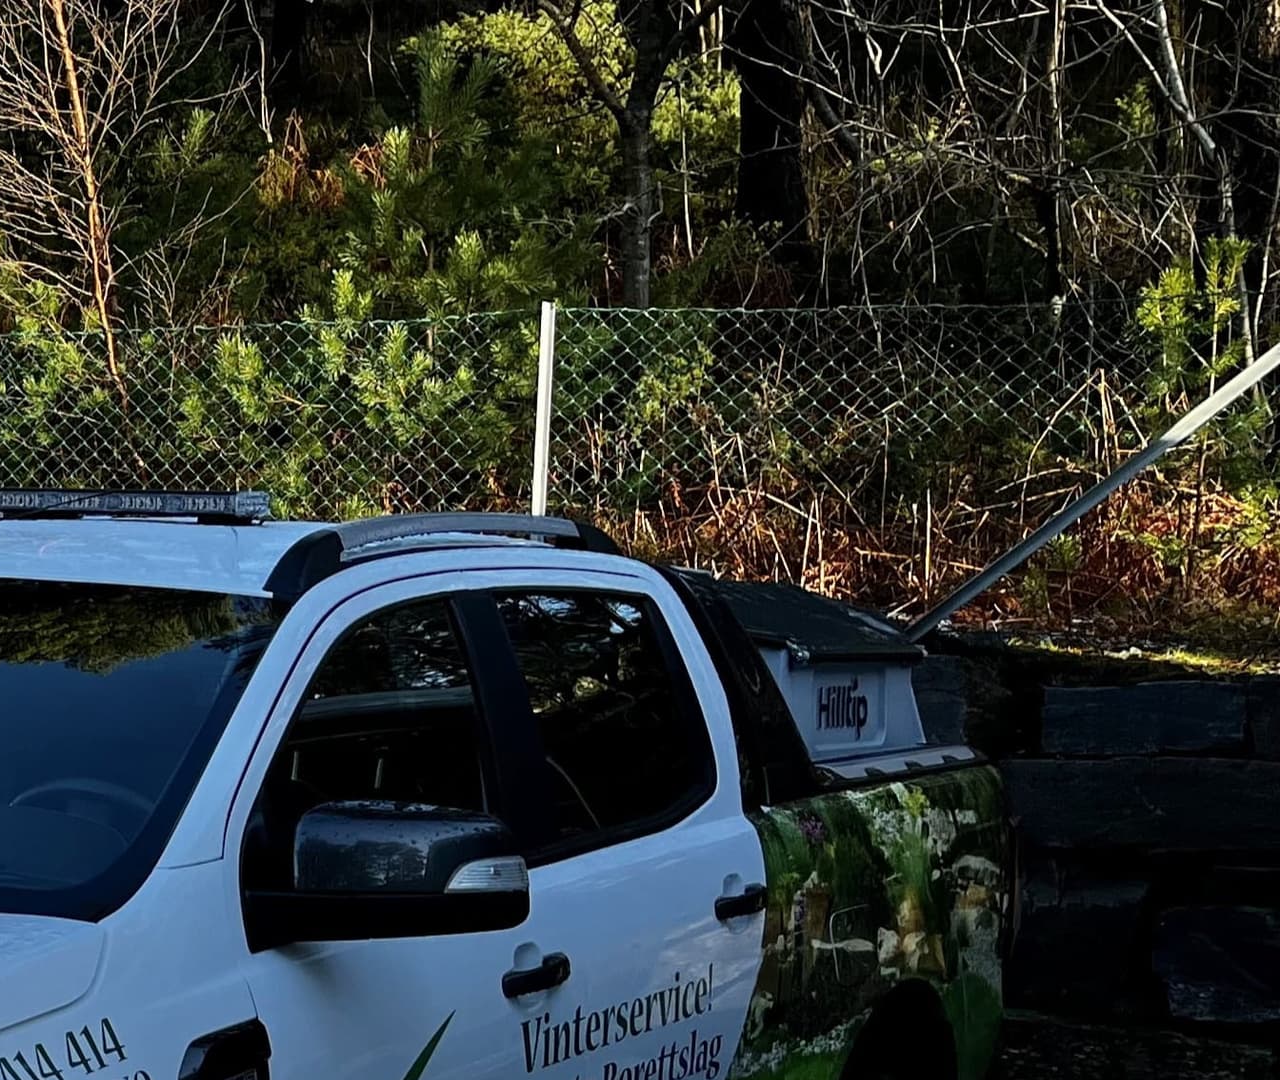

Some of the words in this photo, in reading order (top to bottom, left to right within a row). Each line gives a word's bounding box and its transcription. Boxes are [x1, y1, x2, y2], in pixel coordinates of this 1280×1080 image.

[816, 676, 868, 741] Hilltip
[65, 1017, 129, 1075] 414
[520, 962, 714, 1074] Vinterservice!
